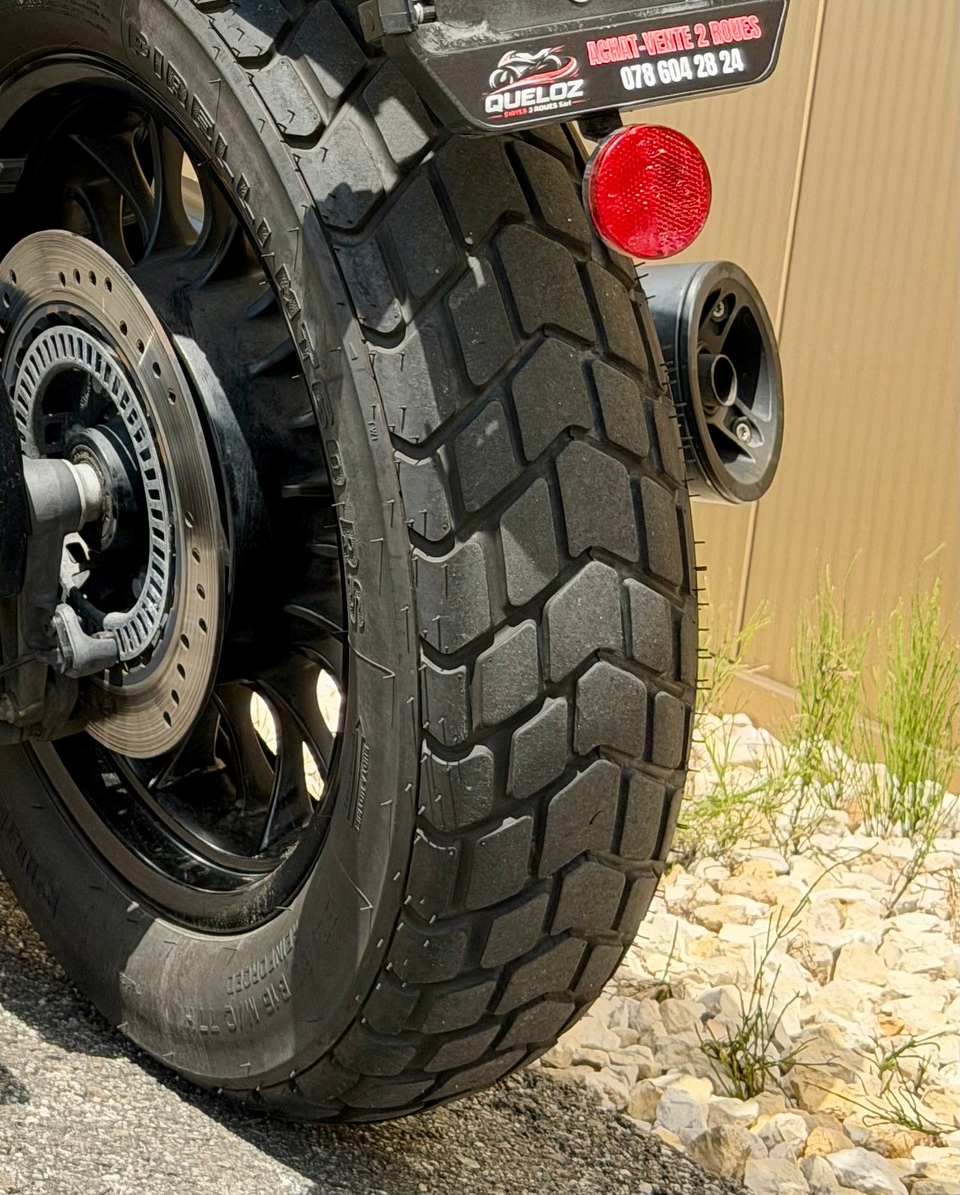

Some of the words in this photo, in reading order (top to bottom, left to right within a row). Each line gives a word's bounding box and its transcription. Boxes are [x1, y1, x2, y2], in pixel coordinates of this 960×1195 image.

[586, 25, 694, 67] ACHAT-VENTE
[694, 22, 710, 49] 2
[708, 14, 762, 46] ROUES
[620, 62, 657, 91] 078
[656, 56, 693, 85] 604
[693, 52, 719, 78] 28
[719, 48, 745, 75] 24
[484, 78, 584, 114] QUELOZ
[528, 106, 534, 114] 2
[534, 102, 558, 113] ROUES
